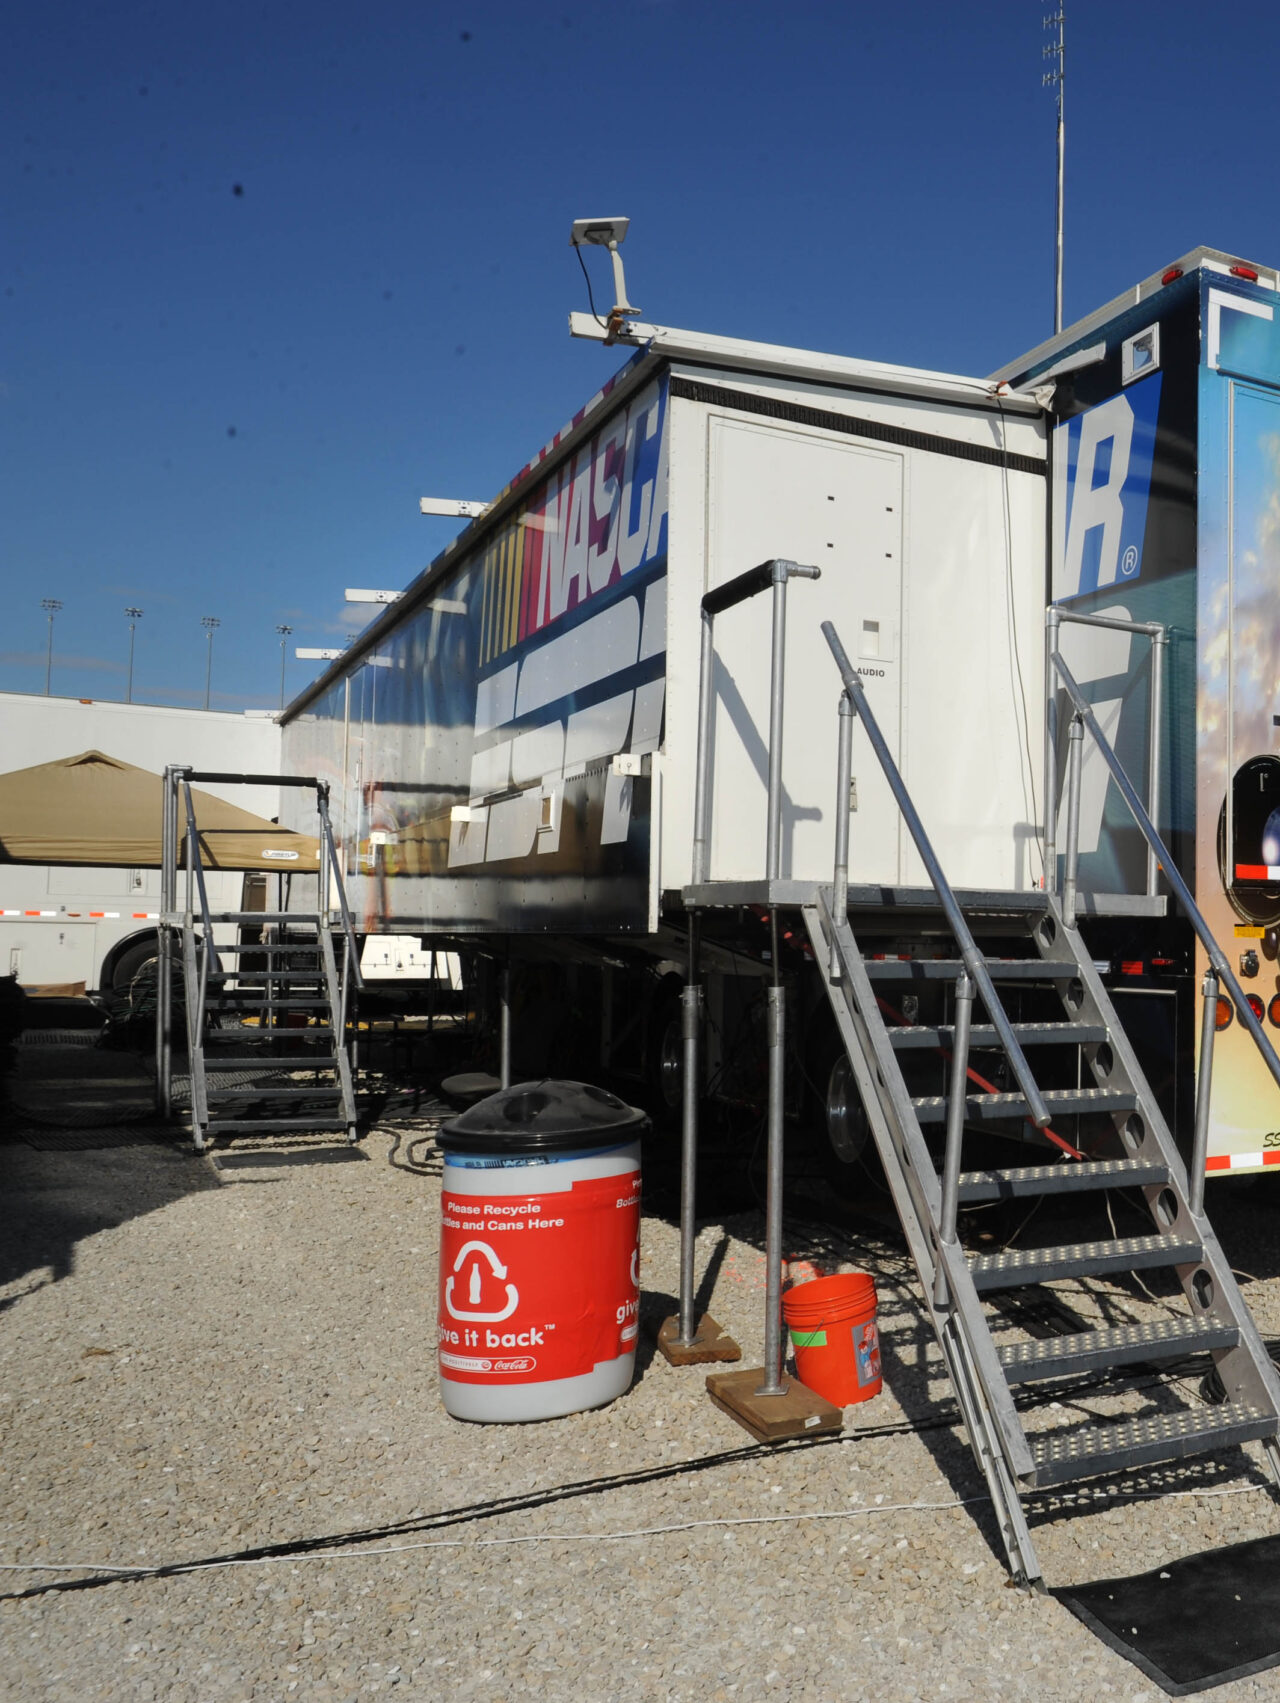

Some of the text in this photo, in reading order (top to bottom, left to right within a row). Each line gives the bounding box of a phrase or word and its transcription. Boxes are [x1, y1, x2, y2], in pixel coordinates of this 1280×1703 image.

[857, 667, 885, 678] AUDIO
[447, 1201, 541, 1217] Please Recycle
[462, 1220, 485, 1231] and
[487, 1219, 524, 1231] Cans
[528, 1217, 565, 1229] Here
[464, 1328, 479, 1347] it
[485, 1327, 545, 1348] back
